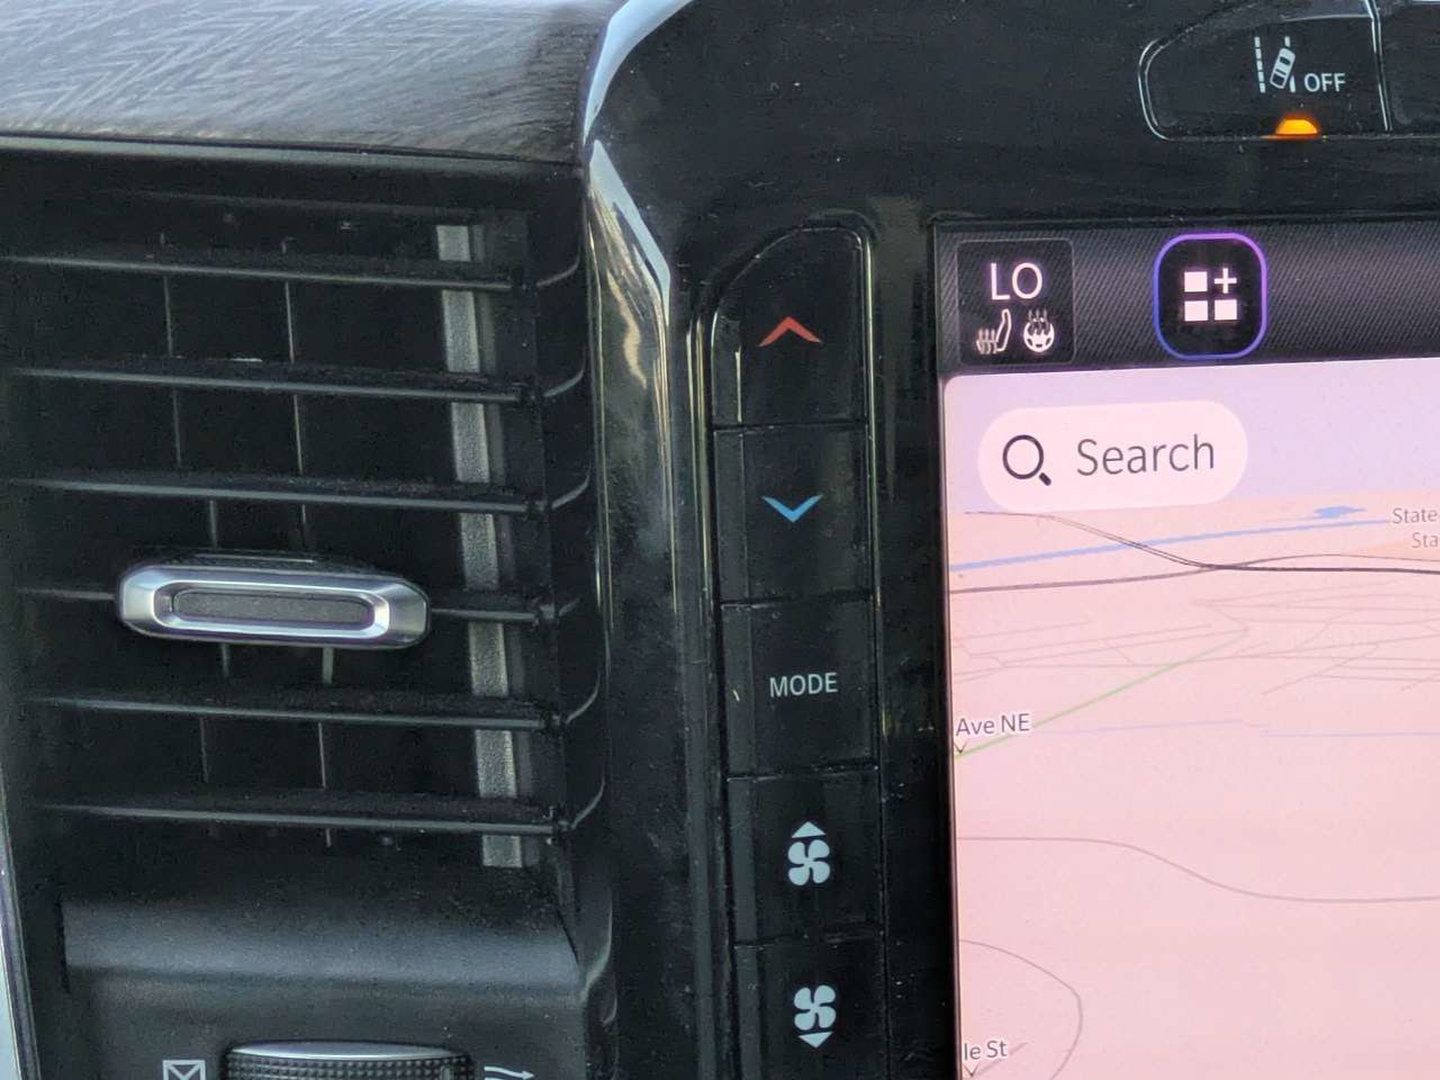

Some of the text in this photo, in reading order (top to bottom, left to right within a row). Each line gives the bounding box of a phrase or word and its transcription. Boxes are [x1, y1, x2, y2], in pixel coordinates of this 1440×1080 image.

[1304, 72, 1346, 93] OFF
[990, 262, 1043, 301] LO
[1076, 433, 1215, 477] Search
[1391, 505, 1437, 525] State
[769, 671, 838, 698] MODE
[956, 713, 1031, 737] Ave NE
[986, 1039, 1008, 1059] St
